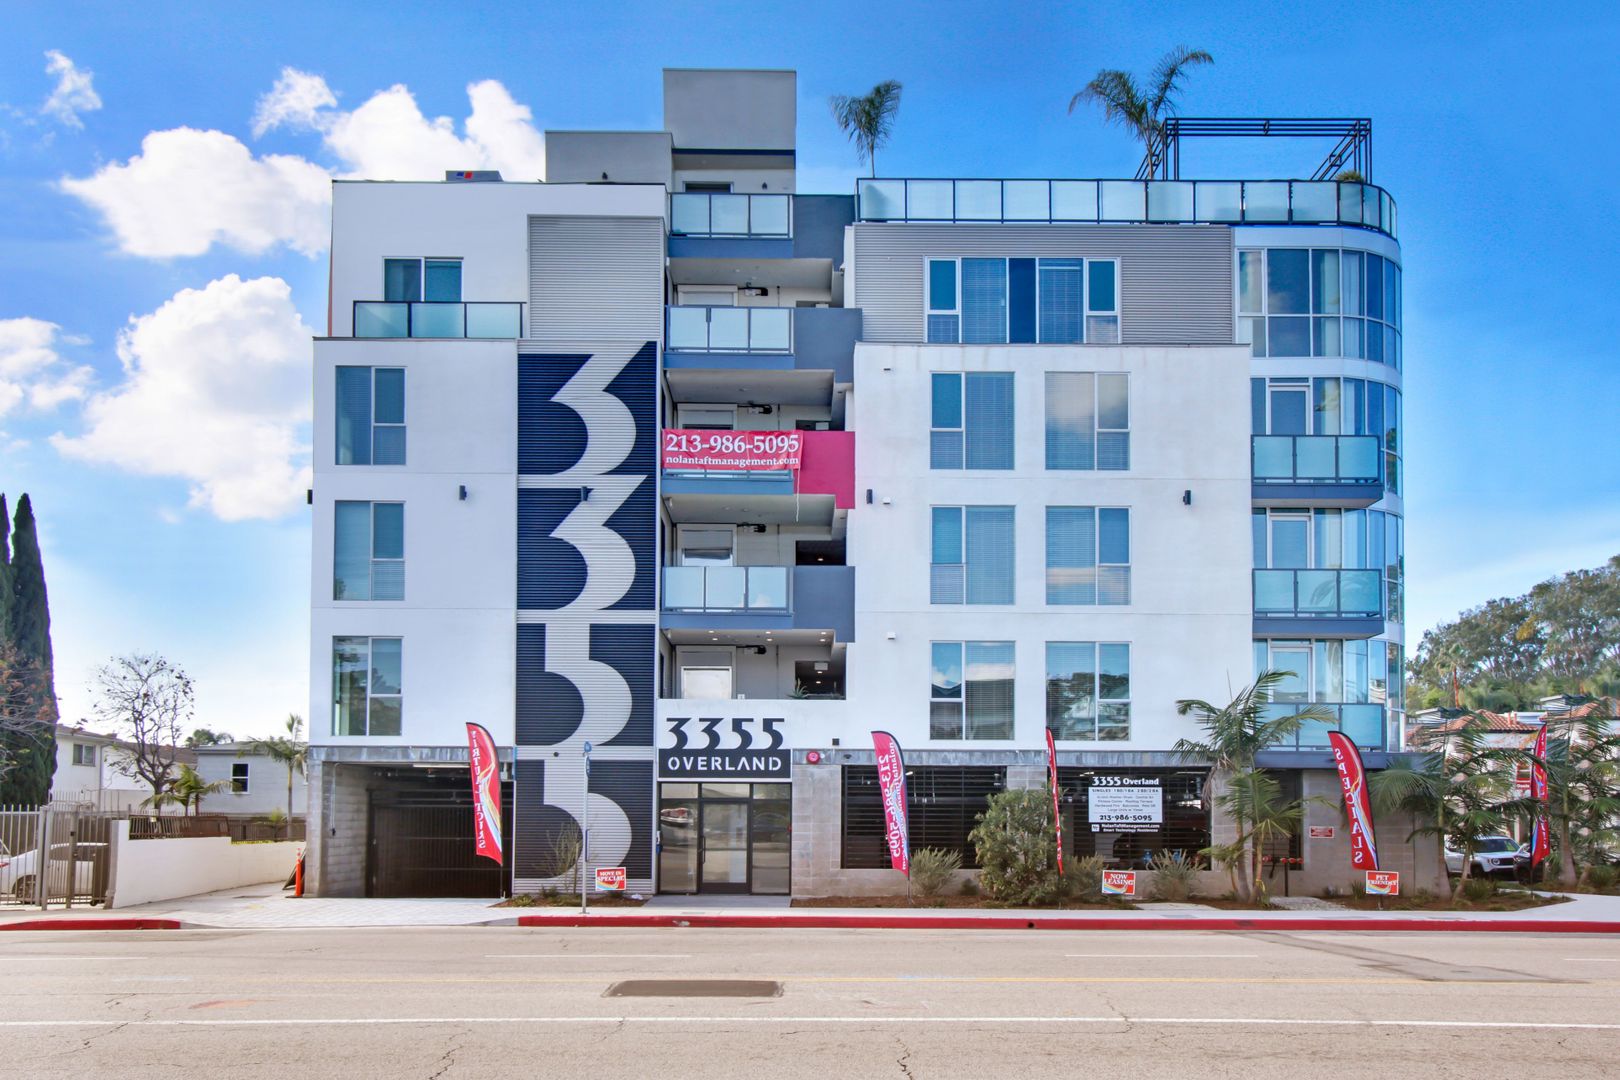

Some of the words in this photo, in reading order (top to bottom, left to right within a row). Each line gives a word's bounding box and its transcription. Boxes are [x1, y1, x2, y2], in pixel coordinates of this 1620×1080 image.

[665, 434, 799, 453] 213-986-5095
[665, 456, 799, 467] nolantaftmanagement.com
[666, 717, 785, 749] 3355
[667, 756, 782, 771] OVERLAND
[1092, 776, 1120, 786] 3355
